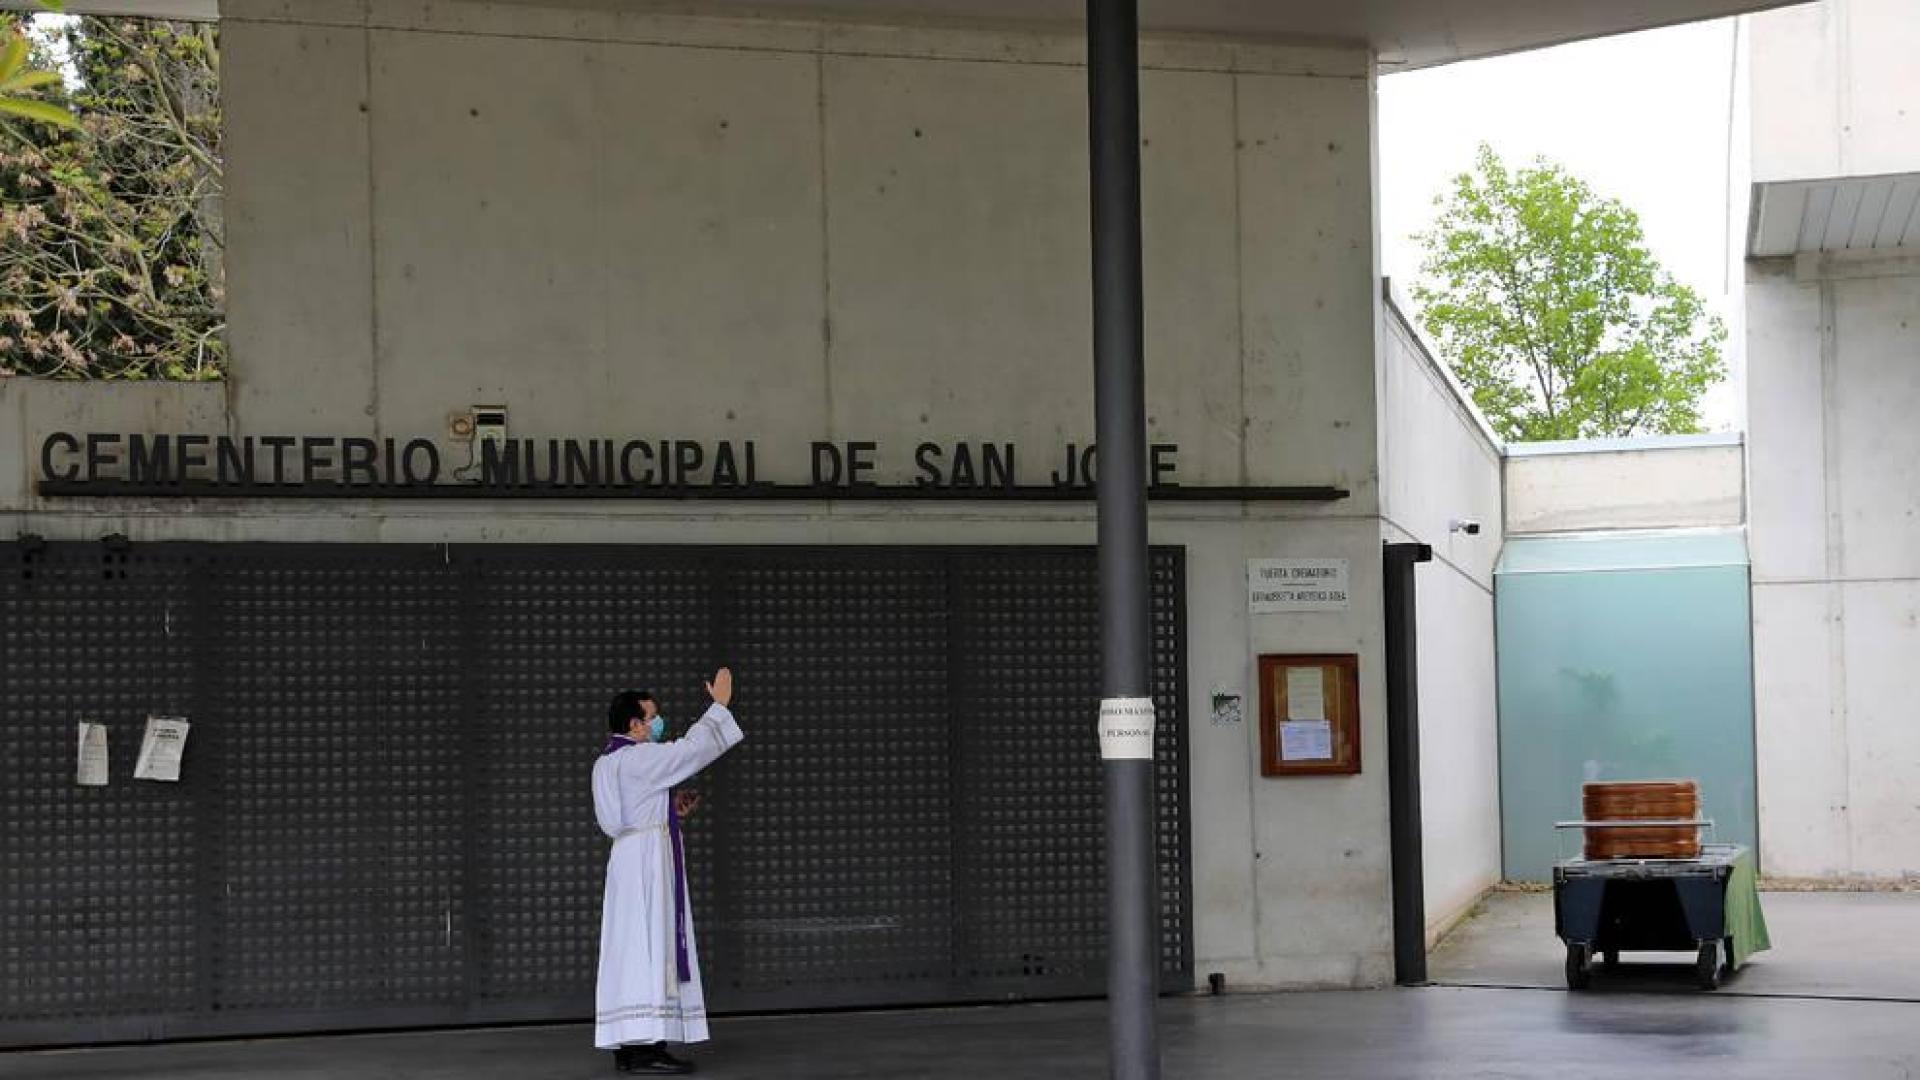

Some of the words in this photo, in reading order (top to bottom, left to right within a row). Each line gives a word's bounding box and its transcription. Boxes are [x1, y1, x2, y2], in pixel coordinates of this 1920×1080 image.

[41, 432, 441, 485] CEMENTERIO
[480, 437, 777, 487] MUNICIPAL
[810, 440, 878, 488] DE
[914, 441, 1016, 488] SAN
